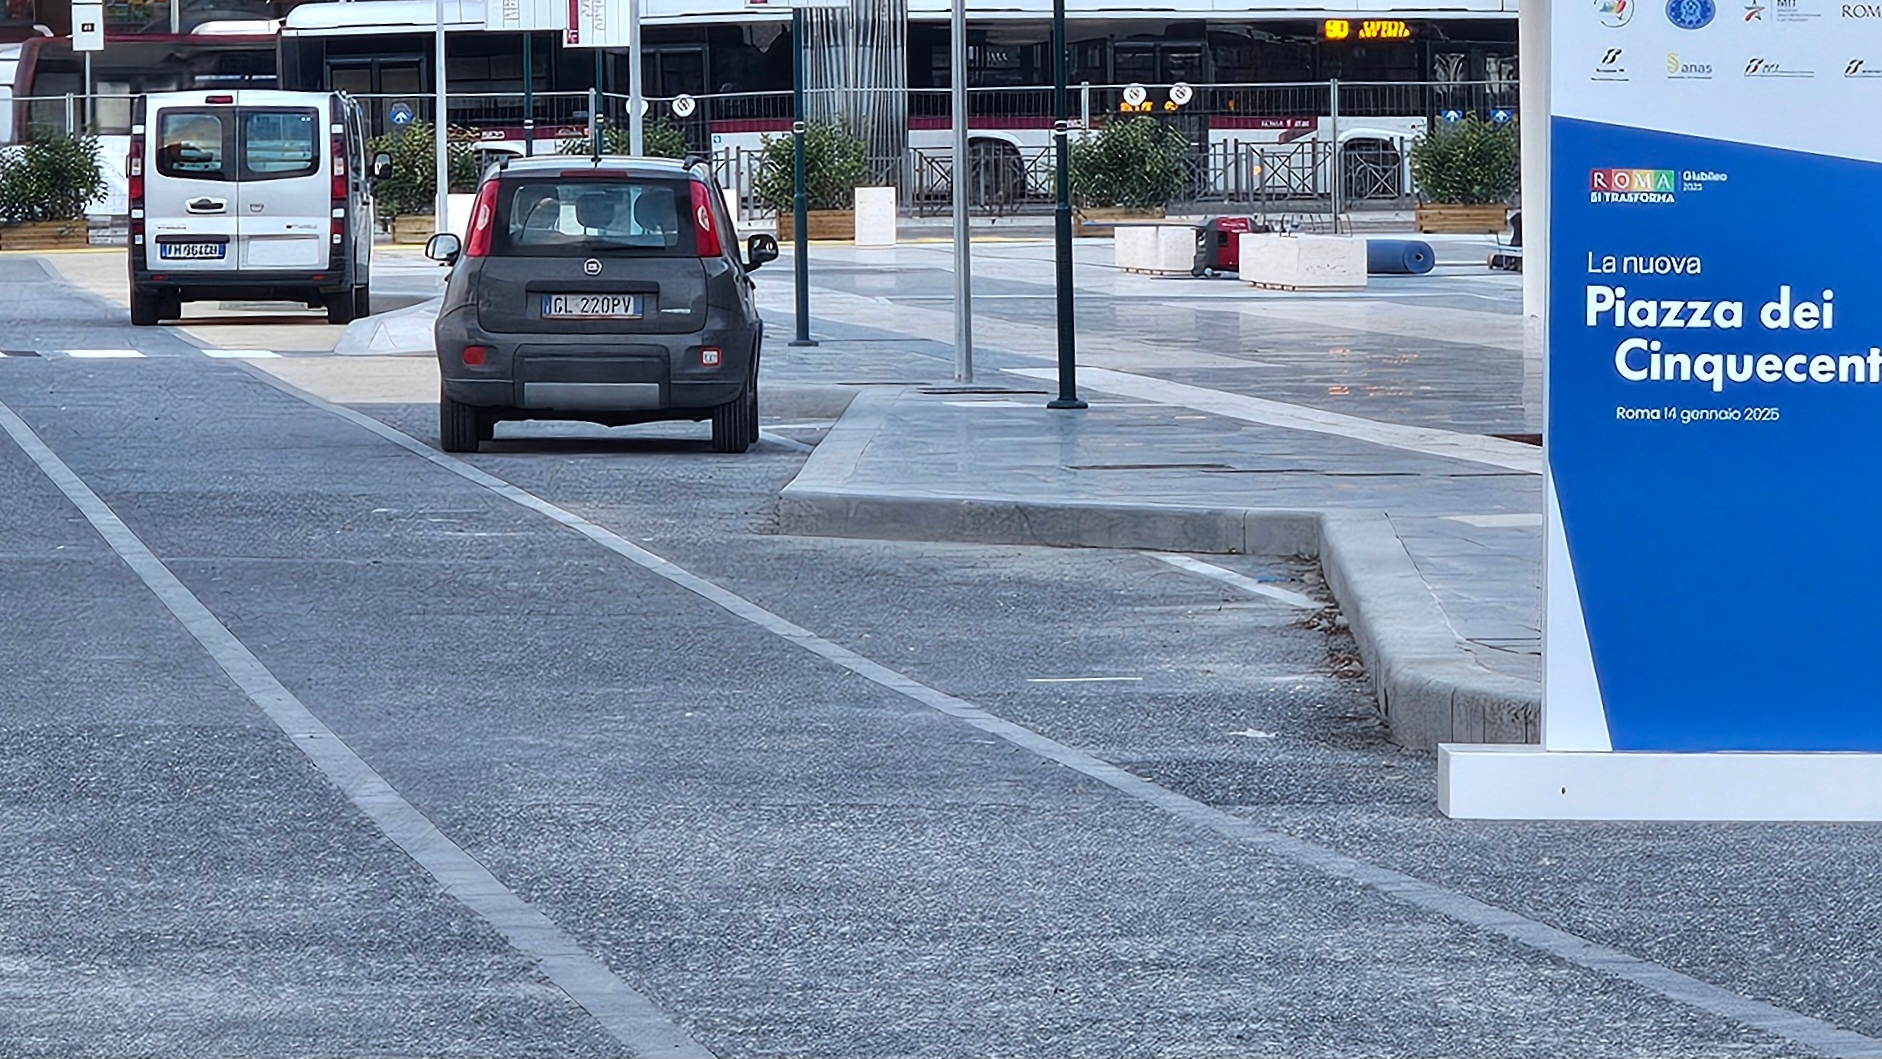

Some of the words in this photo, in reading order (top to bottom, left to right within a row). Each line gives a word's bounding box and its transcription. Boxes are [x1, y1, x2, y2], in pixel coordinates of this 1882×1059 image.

[1593, 172, 1671, 189] ROMA
[1587, 251, 1616, 274] La
[1622, 255, 1702, 275] nuova
[1585, 284, 1743, 329] Piazza
[1759, 284, 1834, 329] dei
[1616, 406, 1660, 420] Roma
[1680, 406, 1741, 424] gennaio
